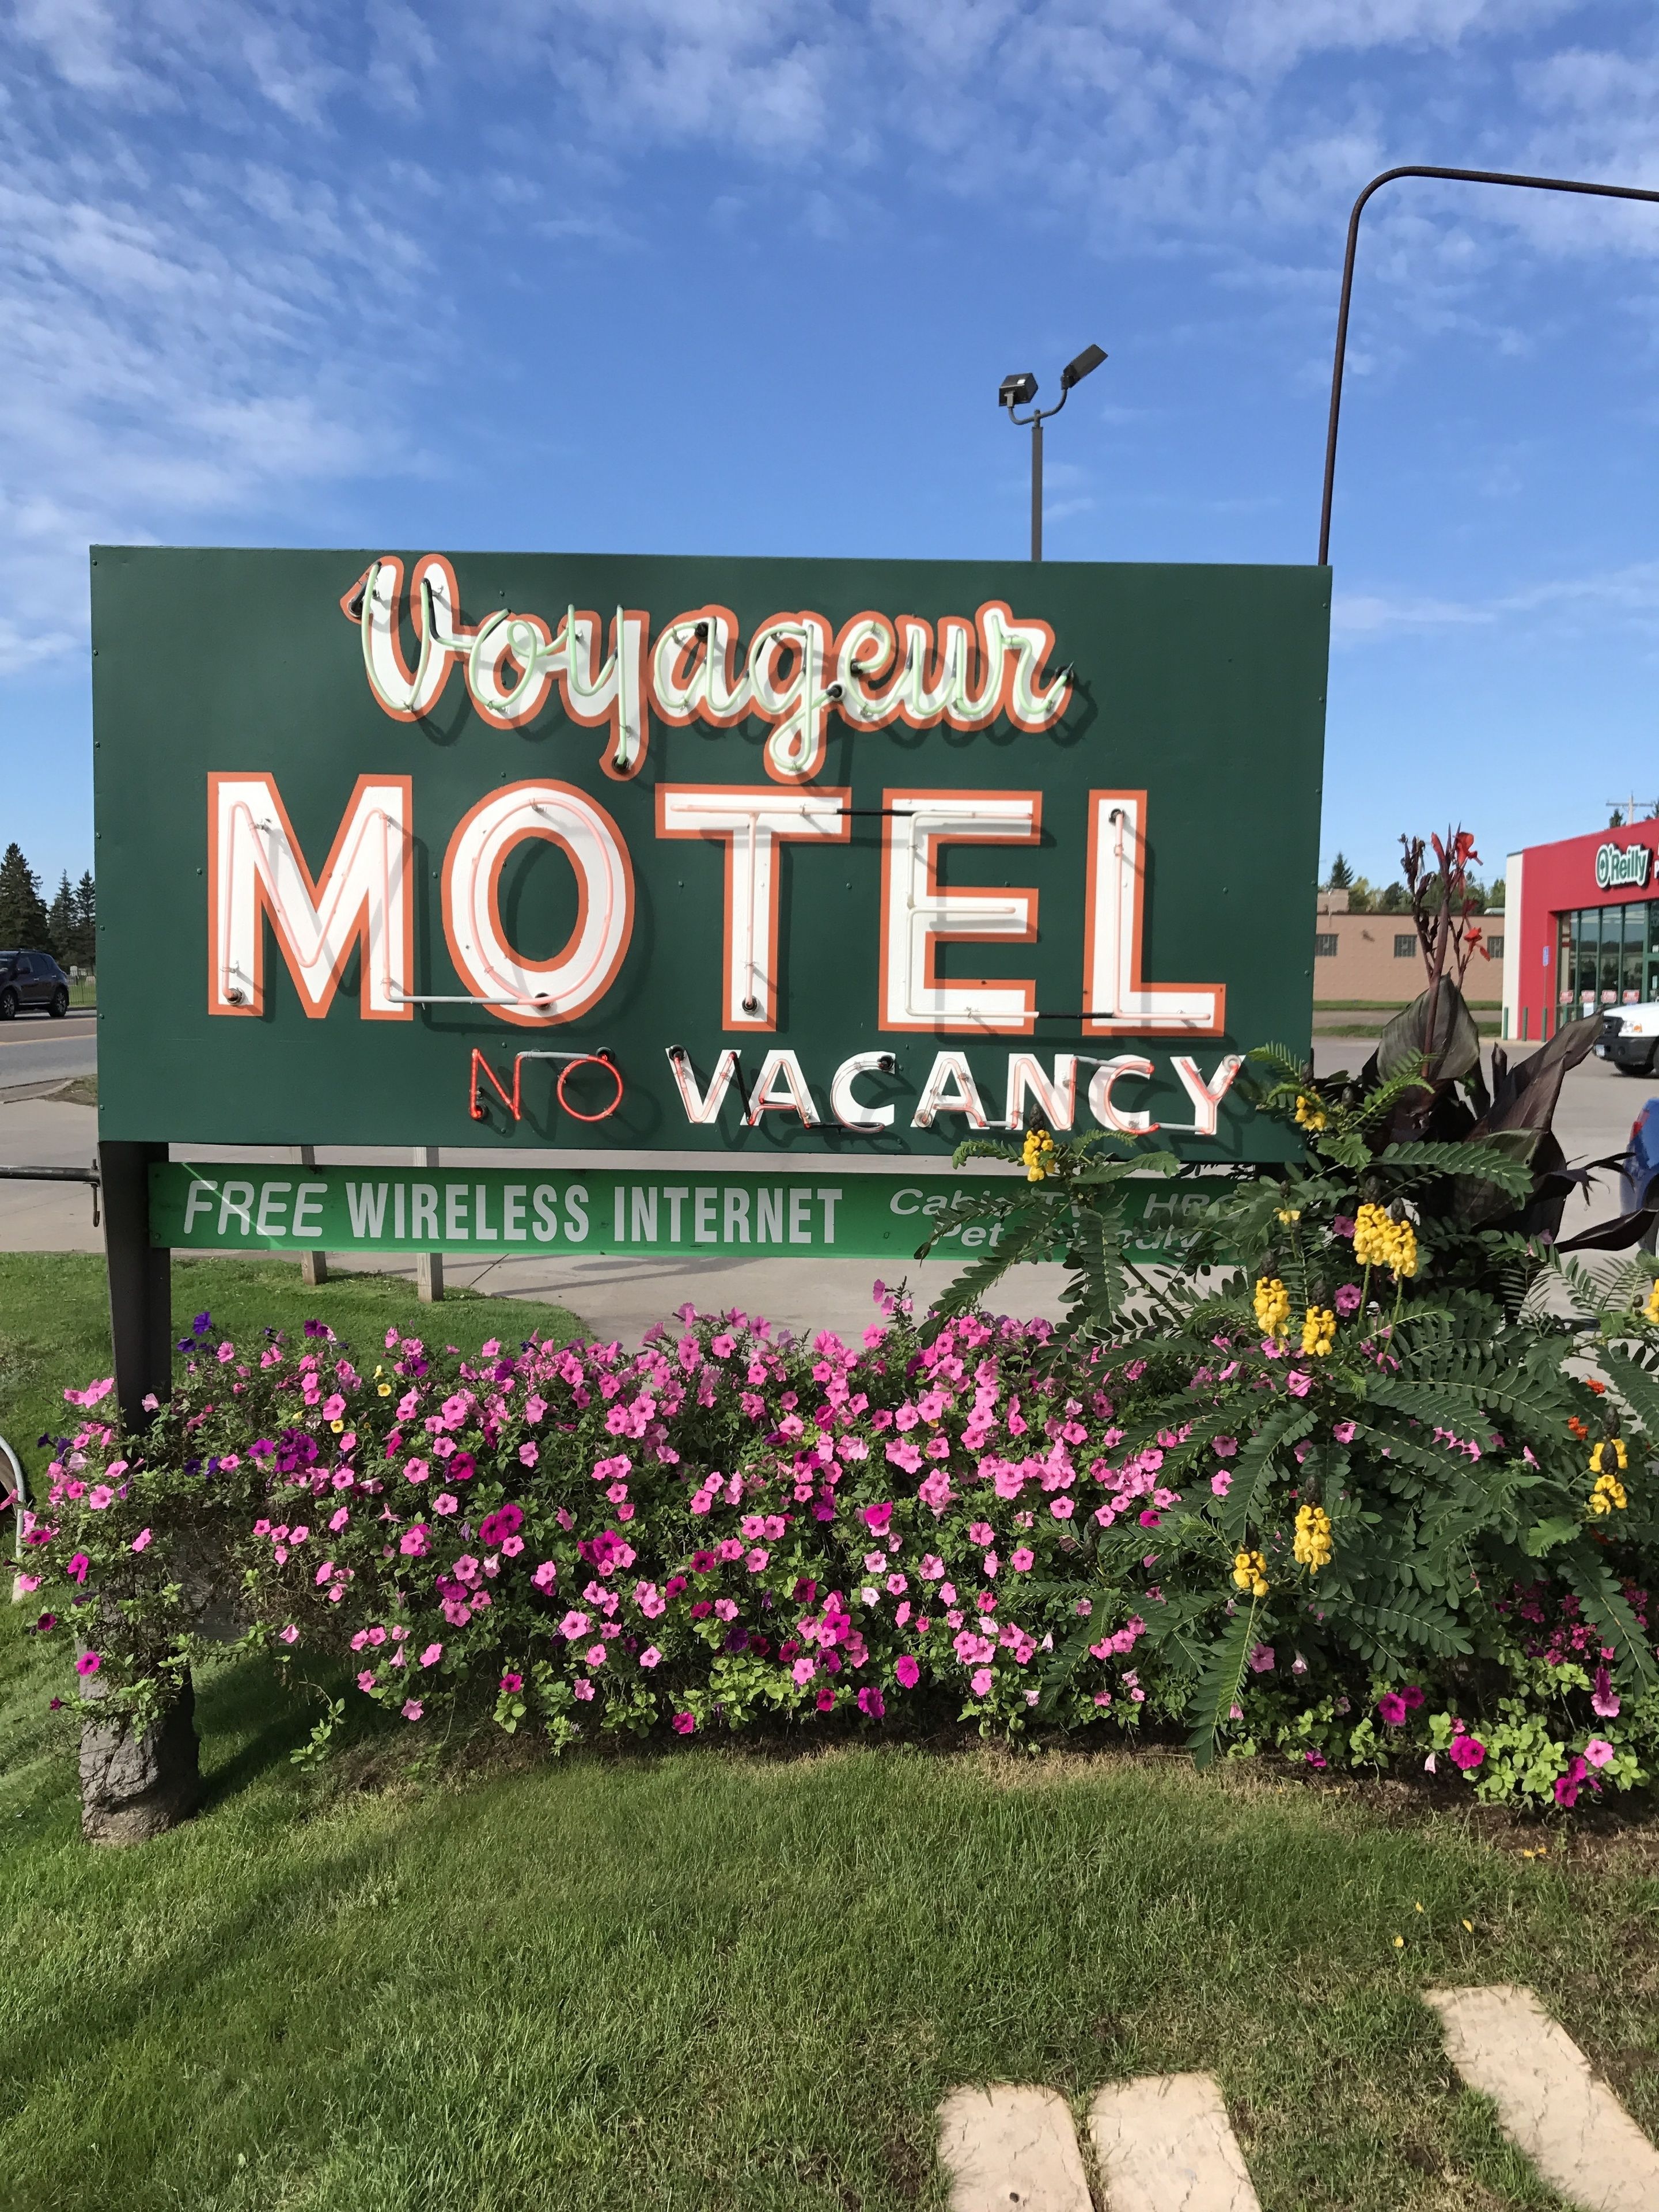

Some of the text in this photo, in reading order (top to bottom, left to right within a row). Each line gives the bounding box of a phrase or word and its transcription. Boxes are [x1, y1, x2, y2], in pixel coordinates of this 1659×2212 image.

[340, 554, 1075, 781] Voyageur
[207, 771, 1226, 1037] MOTEL
[1596, 843, 1650, 888] O'Reilly
[470, 1047, 1244, 1135] NO VACANCY
[184, 1180, 843, 1244] FREE WIRELESS INTERNET
